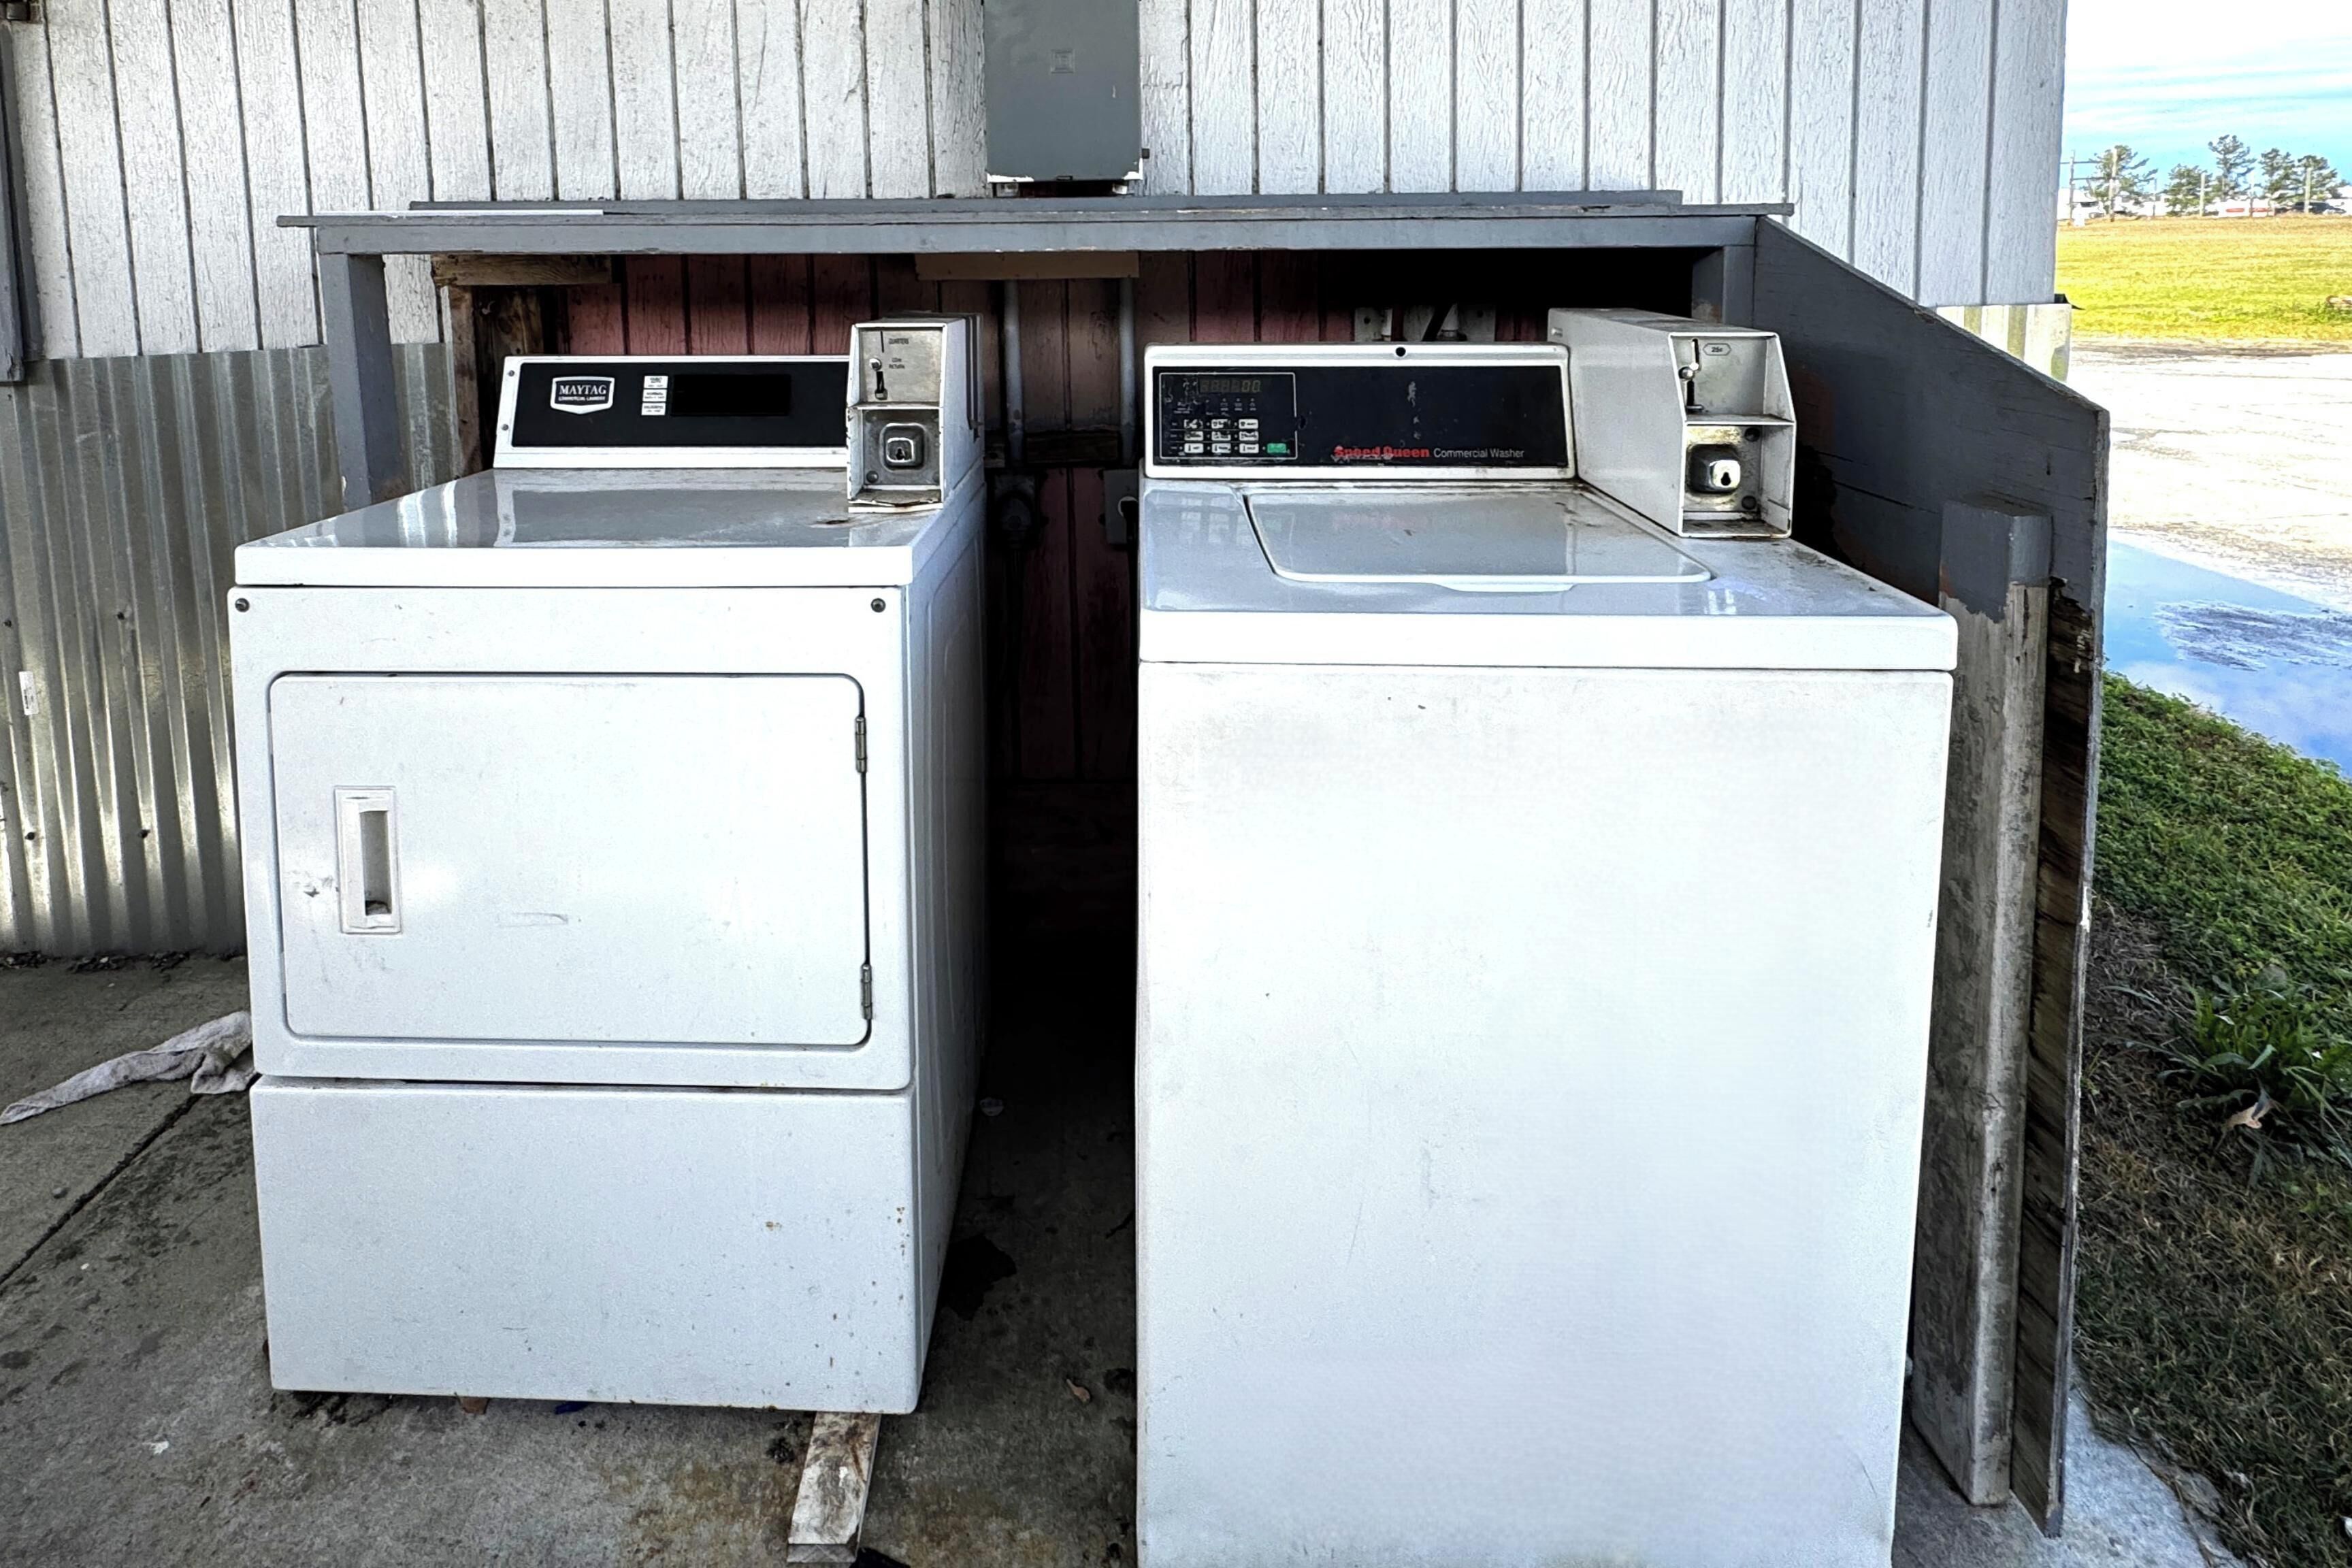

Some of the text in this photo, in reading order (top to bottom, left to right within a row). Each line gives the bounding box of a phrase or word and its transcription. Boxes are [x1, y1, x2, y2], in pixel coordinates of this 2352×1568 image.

[559, 385, 607, 395] MAYTAG
[1334, 446, 1524, 458] Speed Queen Commercial Washer
